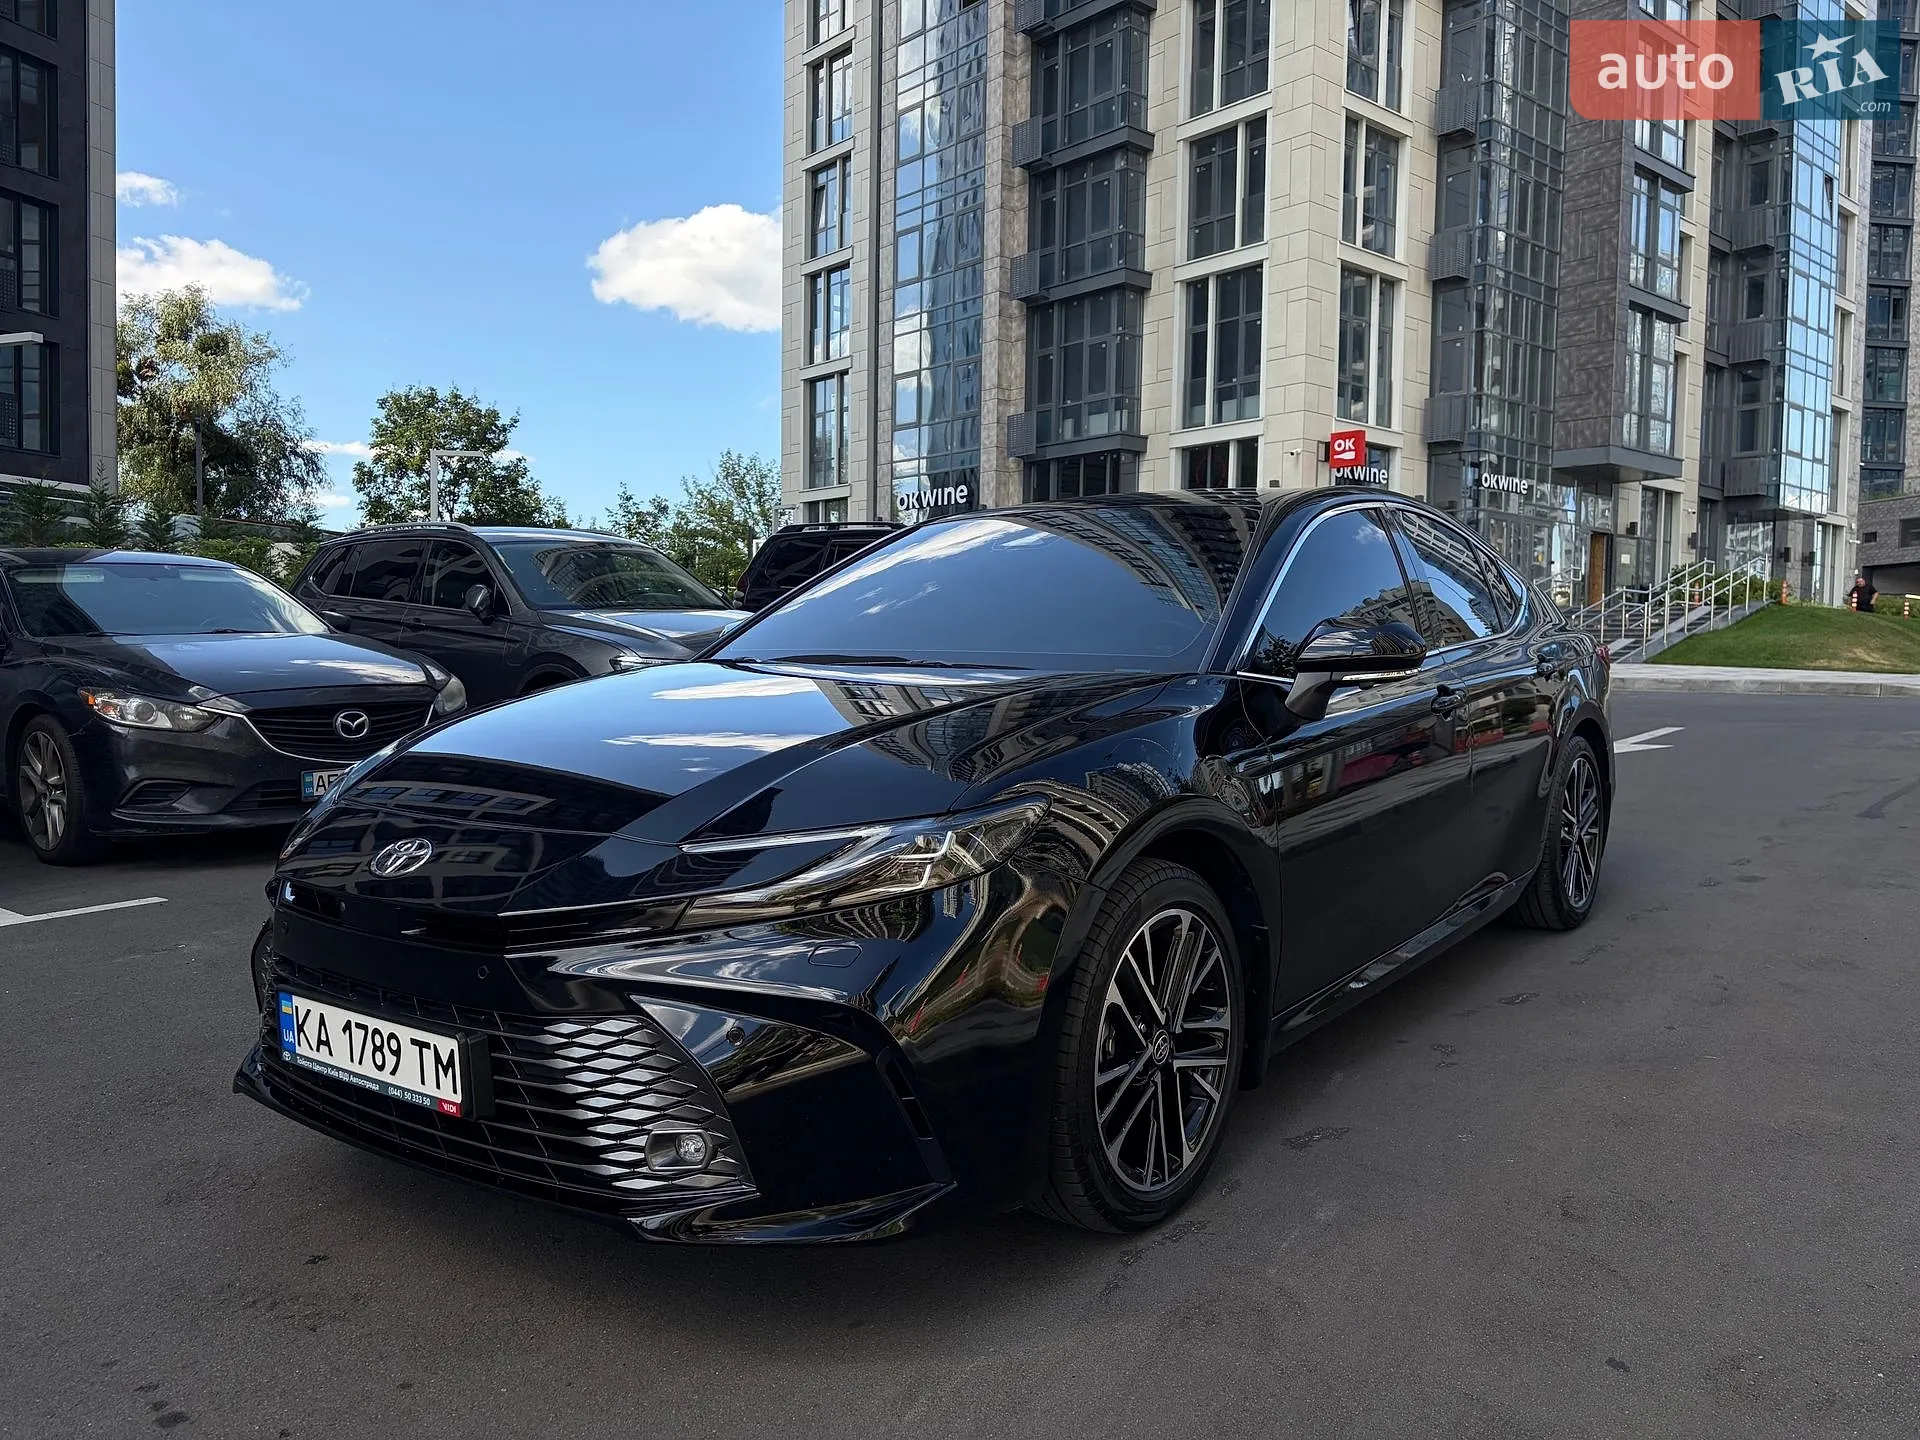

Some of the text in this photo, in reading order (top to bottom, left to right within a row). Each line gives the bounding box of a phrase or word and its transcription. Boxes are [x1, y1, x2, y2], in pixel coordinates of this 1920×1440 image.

[1334, 437, 1356, 452] OK
[283, 1028, 295, 1044] UA
[294, 1005, 458, 1095] KA 1789 TM
[388, 1086, 403, 1098] (044)
[404, 1091, 412, 1100] 50
[422, 1097, 431, 1106] 50
[442, 1102, 457, 1113] VIDI
